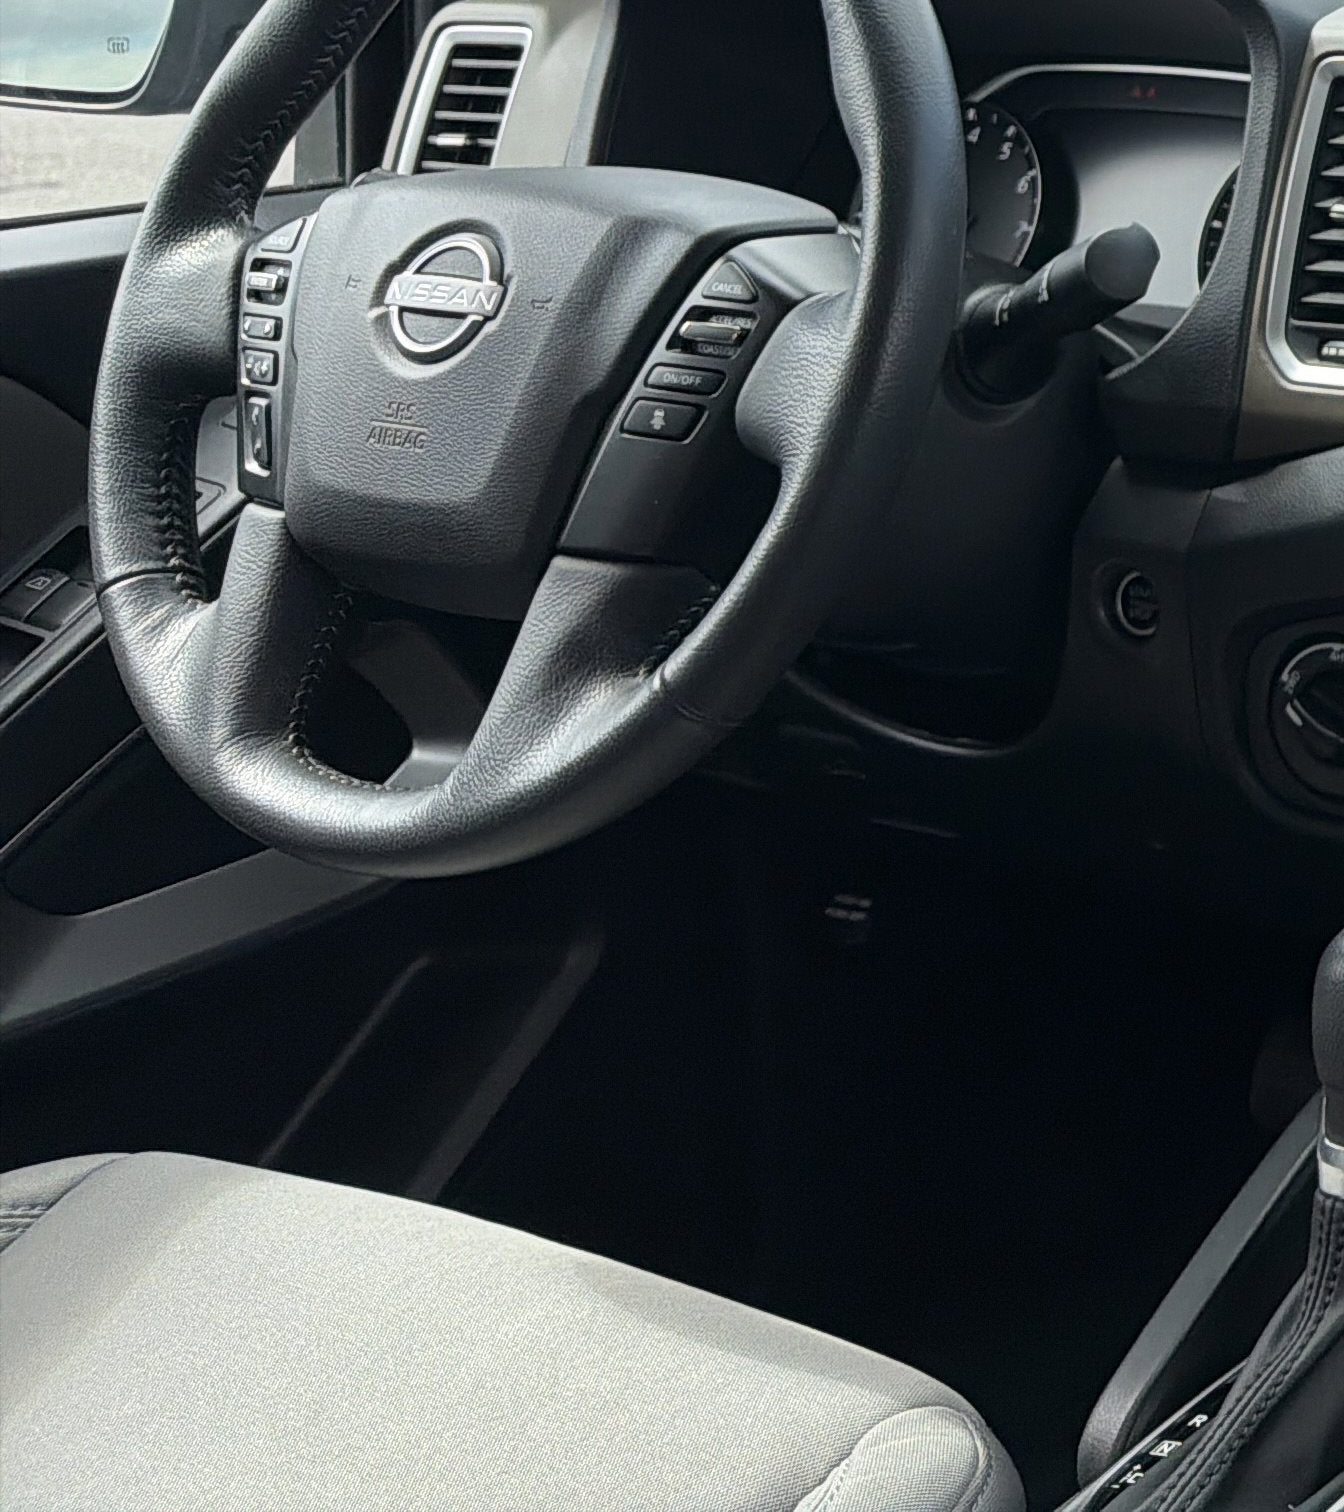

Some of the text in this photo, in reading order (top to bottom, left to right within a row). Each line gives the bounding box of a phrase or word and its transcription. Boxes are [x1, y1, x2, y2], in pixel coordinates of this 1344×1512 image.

[967, 126, 981, 144] 4
[997, 141, 1014, 161] 5
[1016, 173, 1032, 194] 6
[388, 281, 499, 312] NISSAN
[663, 372, 703, 387] ON/OFF
[384, 399, 417, 421] SRS
[366, 427, 429, 451] AIRBAG
[1187, 1414, 1208, 1428] R
